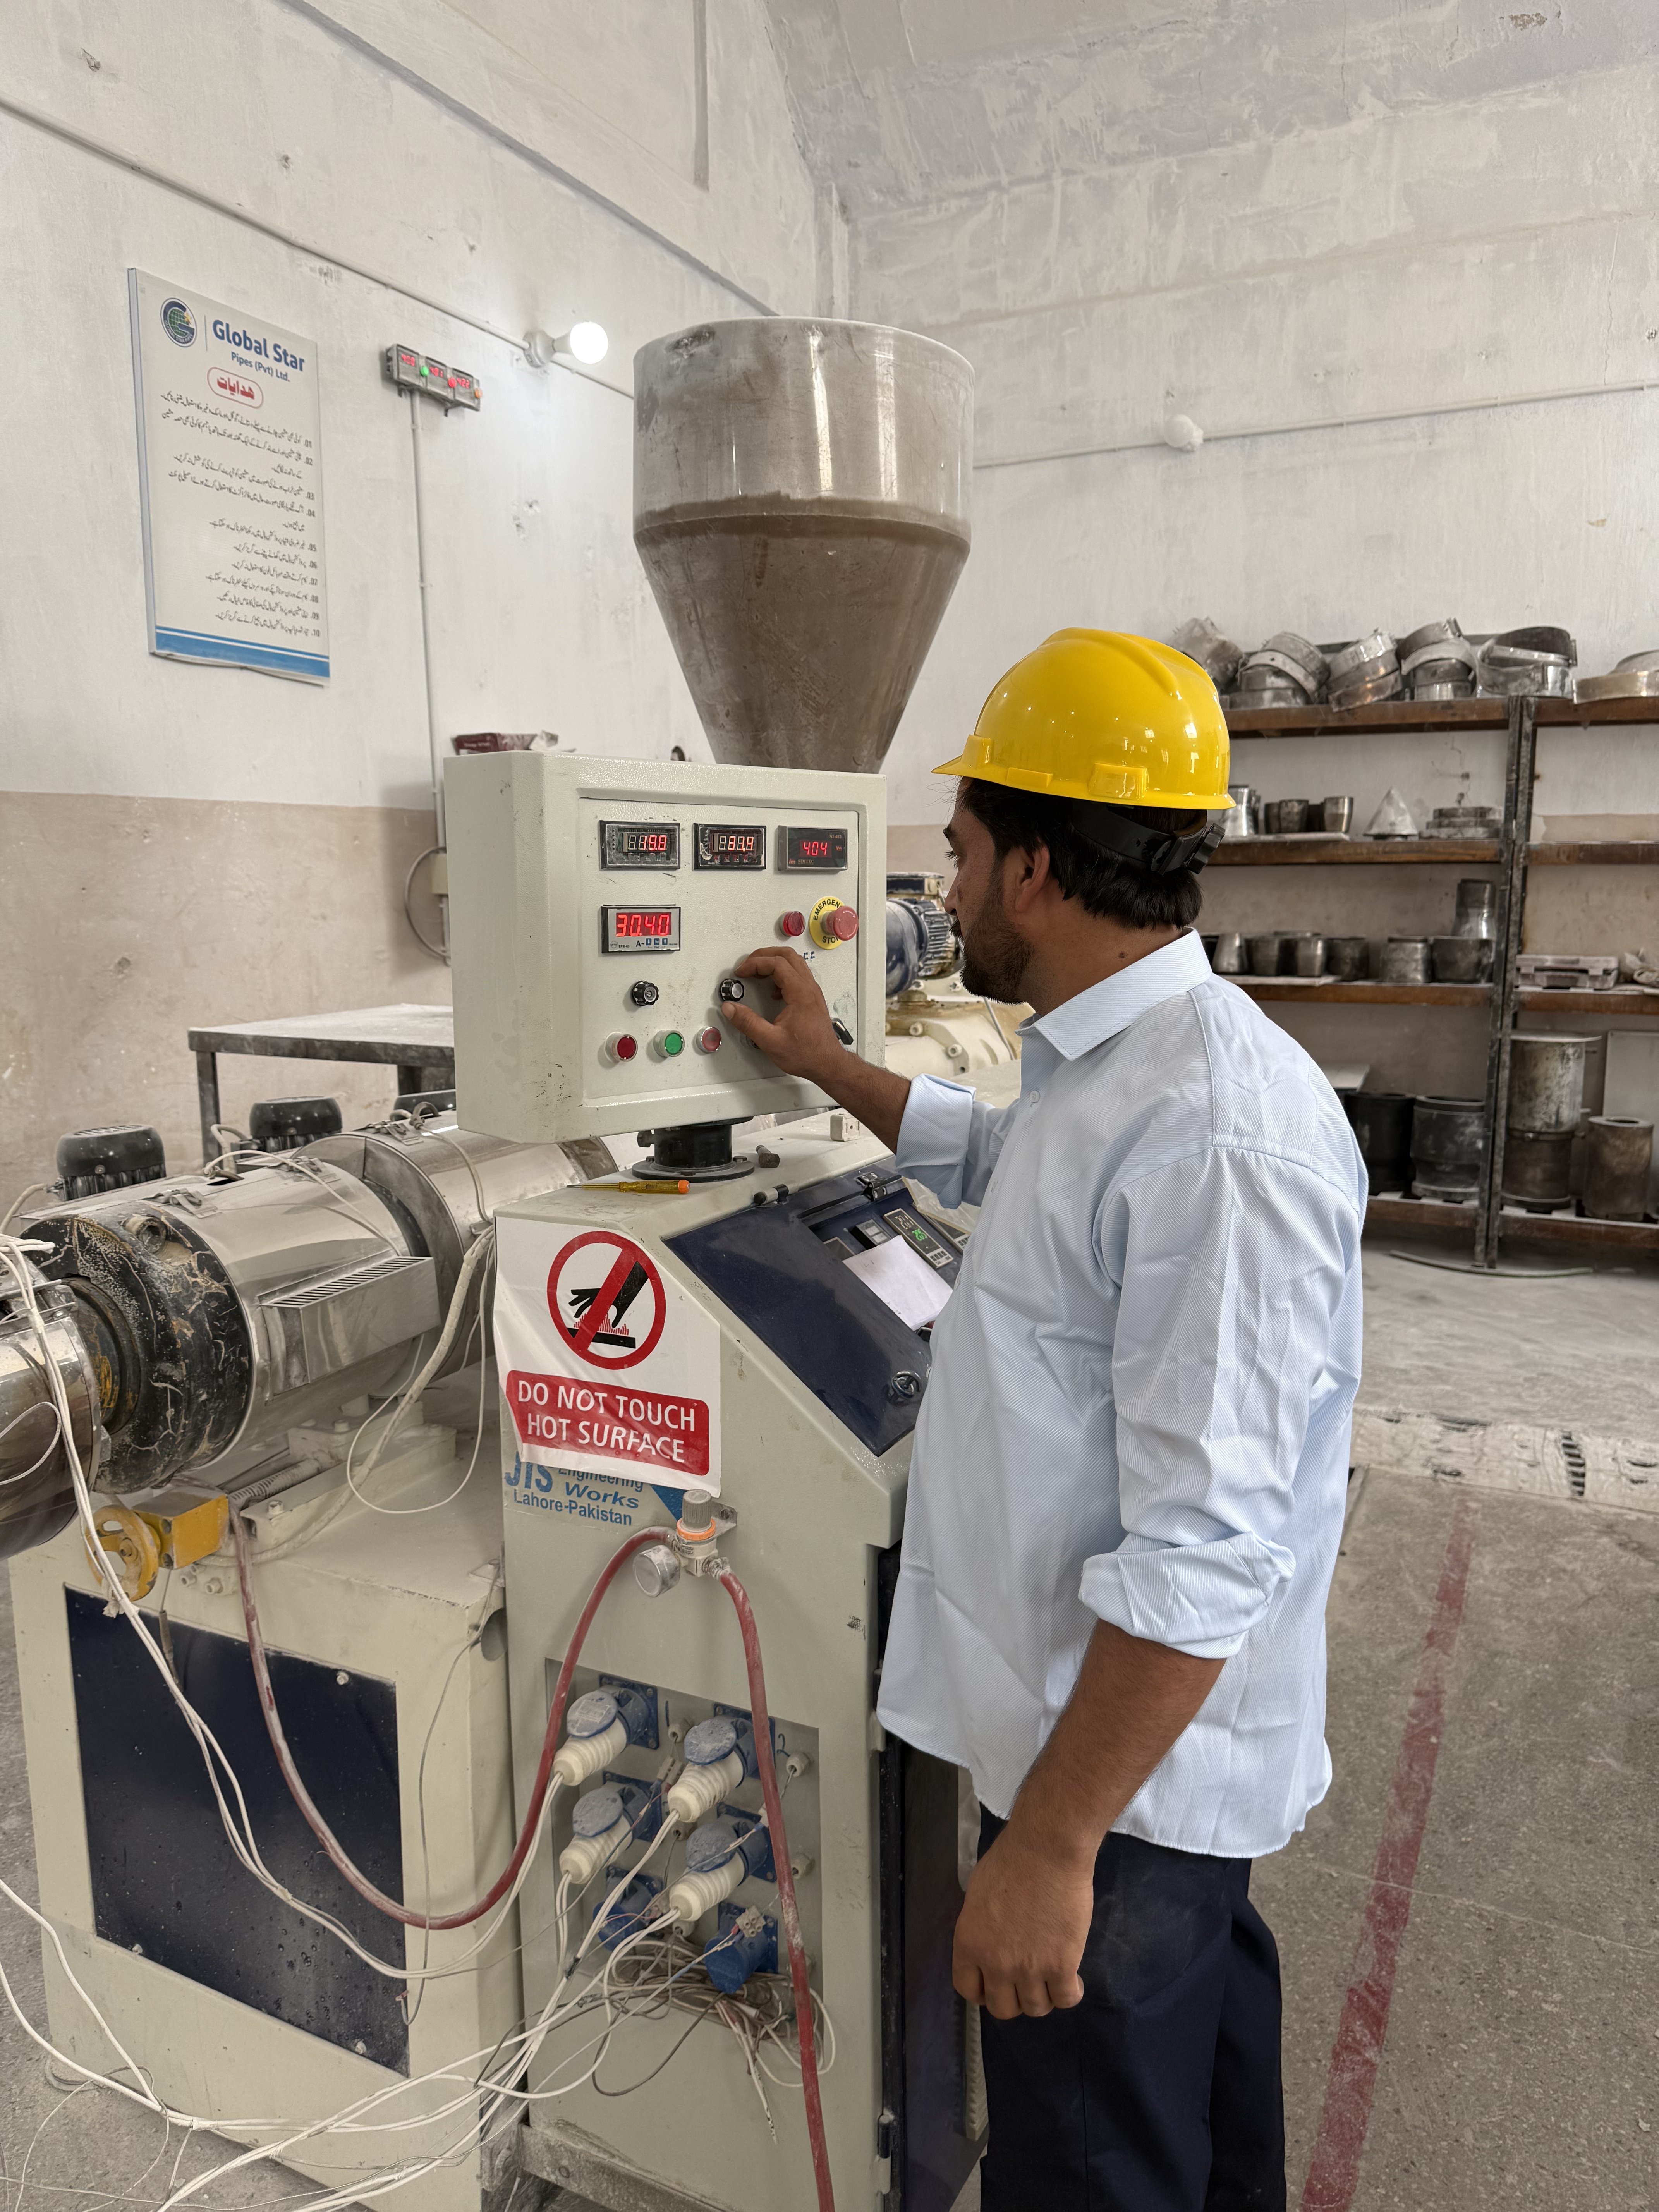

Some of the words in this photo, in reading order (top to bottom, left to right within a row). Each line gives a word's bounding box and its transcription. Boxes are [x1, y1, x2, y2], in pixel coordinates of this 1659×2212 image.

[212, 319, 269, 359] Global
[272, 343, 305, 371] Star
[231, 351, 252, 368] Pipes
[255, 361, 273, 377] (Pvt)
[275, 369, 290, 382] Ltd.
[803, 841, 828, 856] 404
[813, 899, 840, 921] EMERGEN
[616, 914, 670, 937] 30.40
[822, 936, 839, 944] STO
[518, 1380, 549, 1406] DO
[558, 1386, 608, 1415] NOT
[615, 1395, 695, 1432] TOUCH
[528, 1413, 572, 1441] HOT
[578, 1421, 685, 1463] SURFACE
[514, 1489, 632, 1526] Lahore-Pakistan
[565, 1482, 639, 1509] Works
